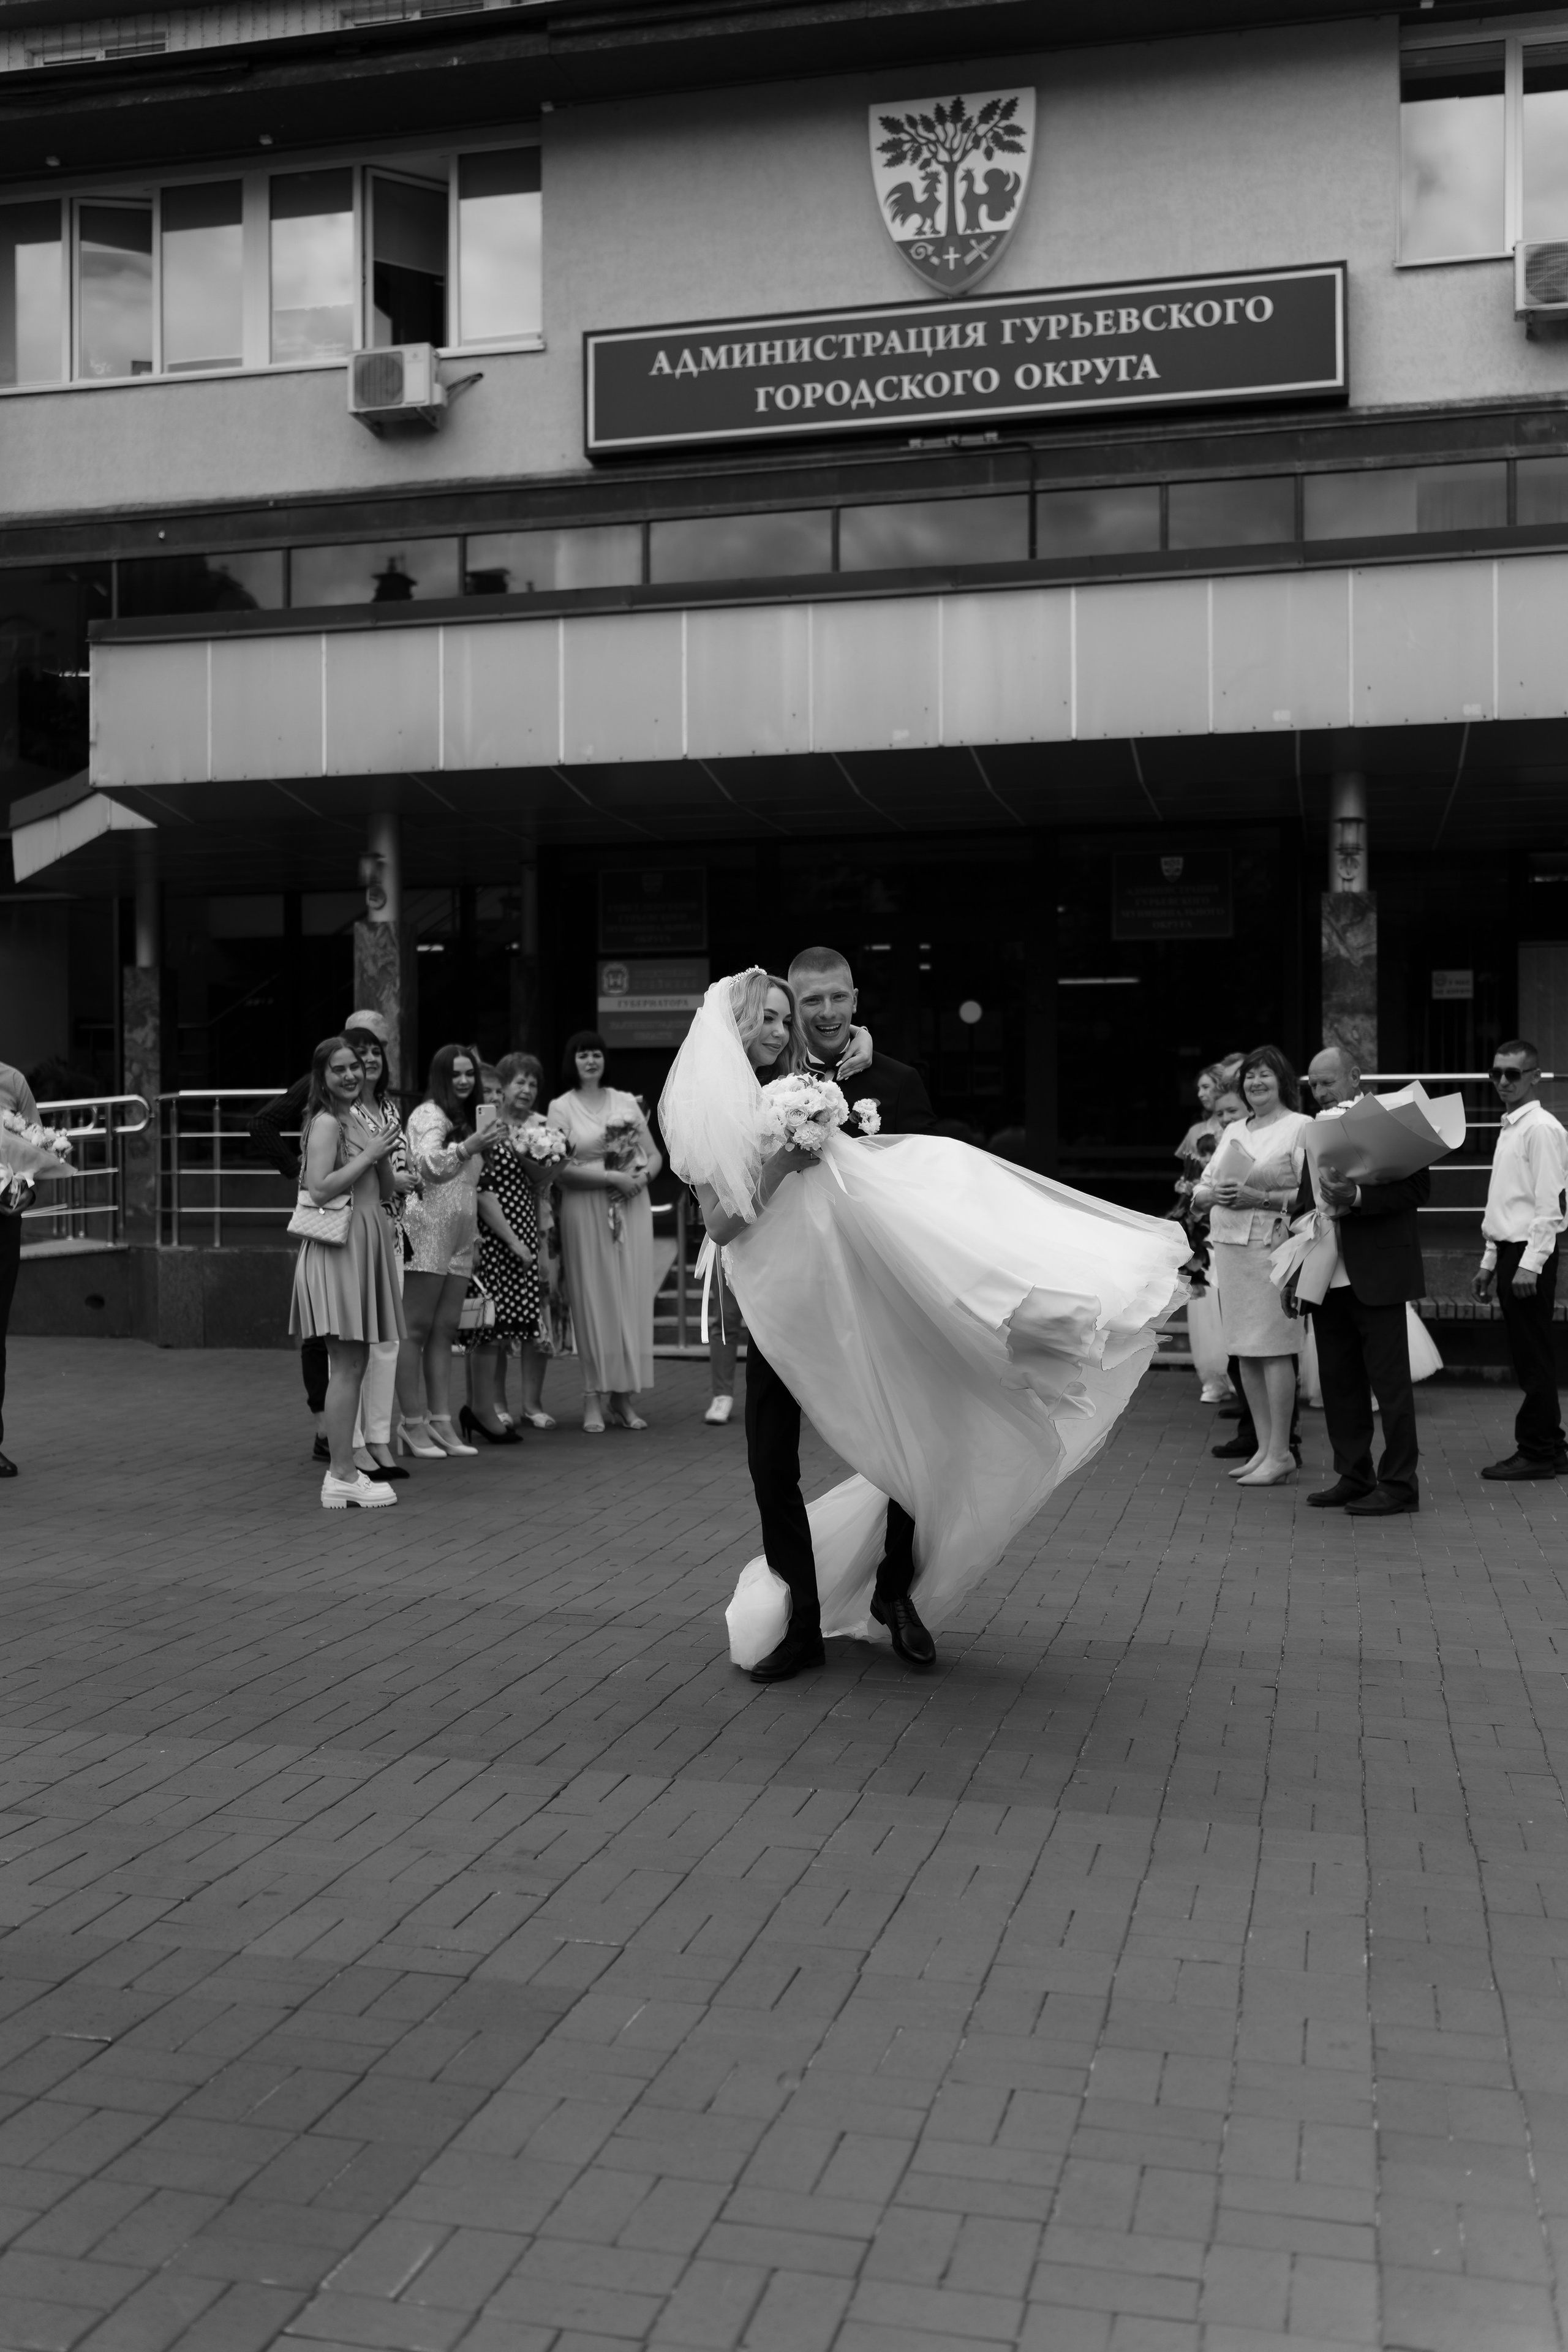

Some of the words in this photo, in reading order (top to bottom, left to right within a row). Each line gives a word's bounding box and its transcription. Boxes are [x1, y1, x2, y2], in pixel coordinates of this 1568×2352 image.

[649, 322, 987, 379] АДМИНИСТРАЦИЯ
[1001, 295, 1274, 344] ГУРЬЕВСКОГО
[756, 367, 1000, 412] ГОРОДСКОГО
[1014, 353, 1161, 390] ОКРУГА
